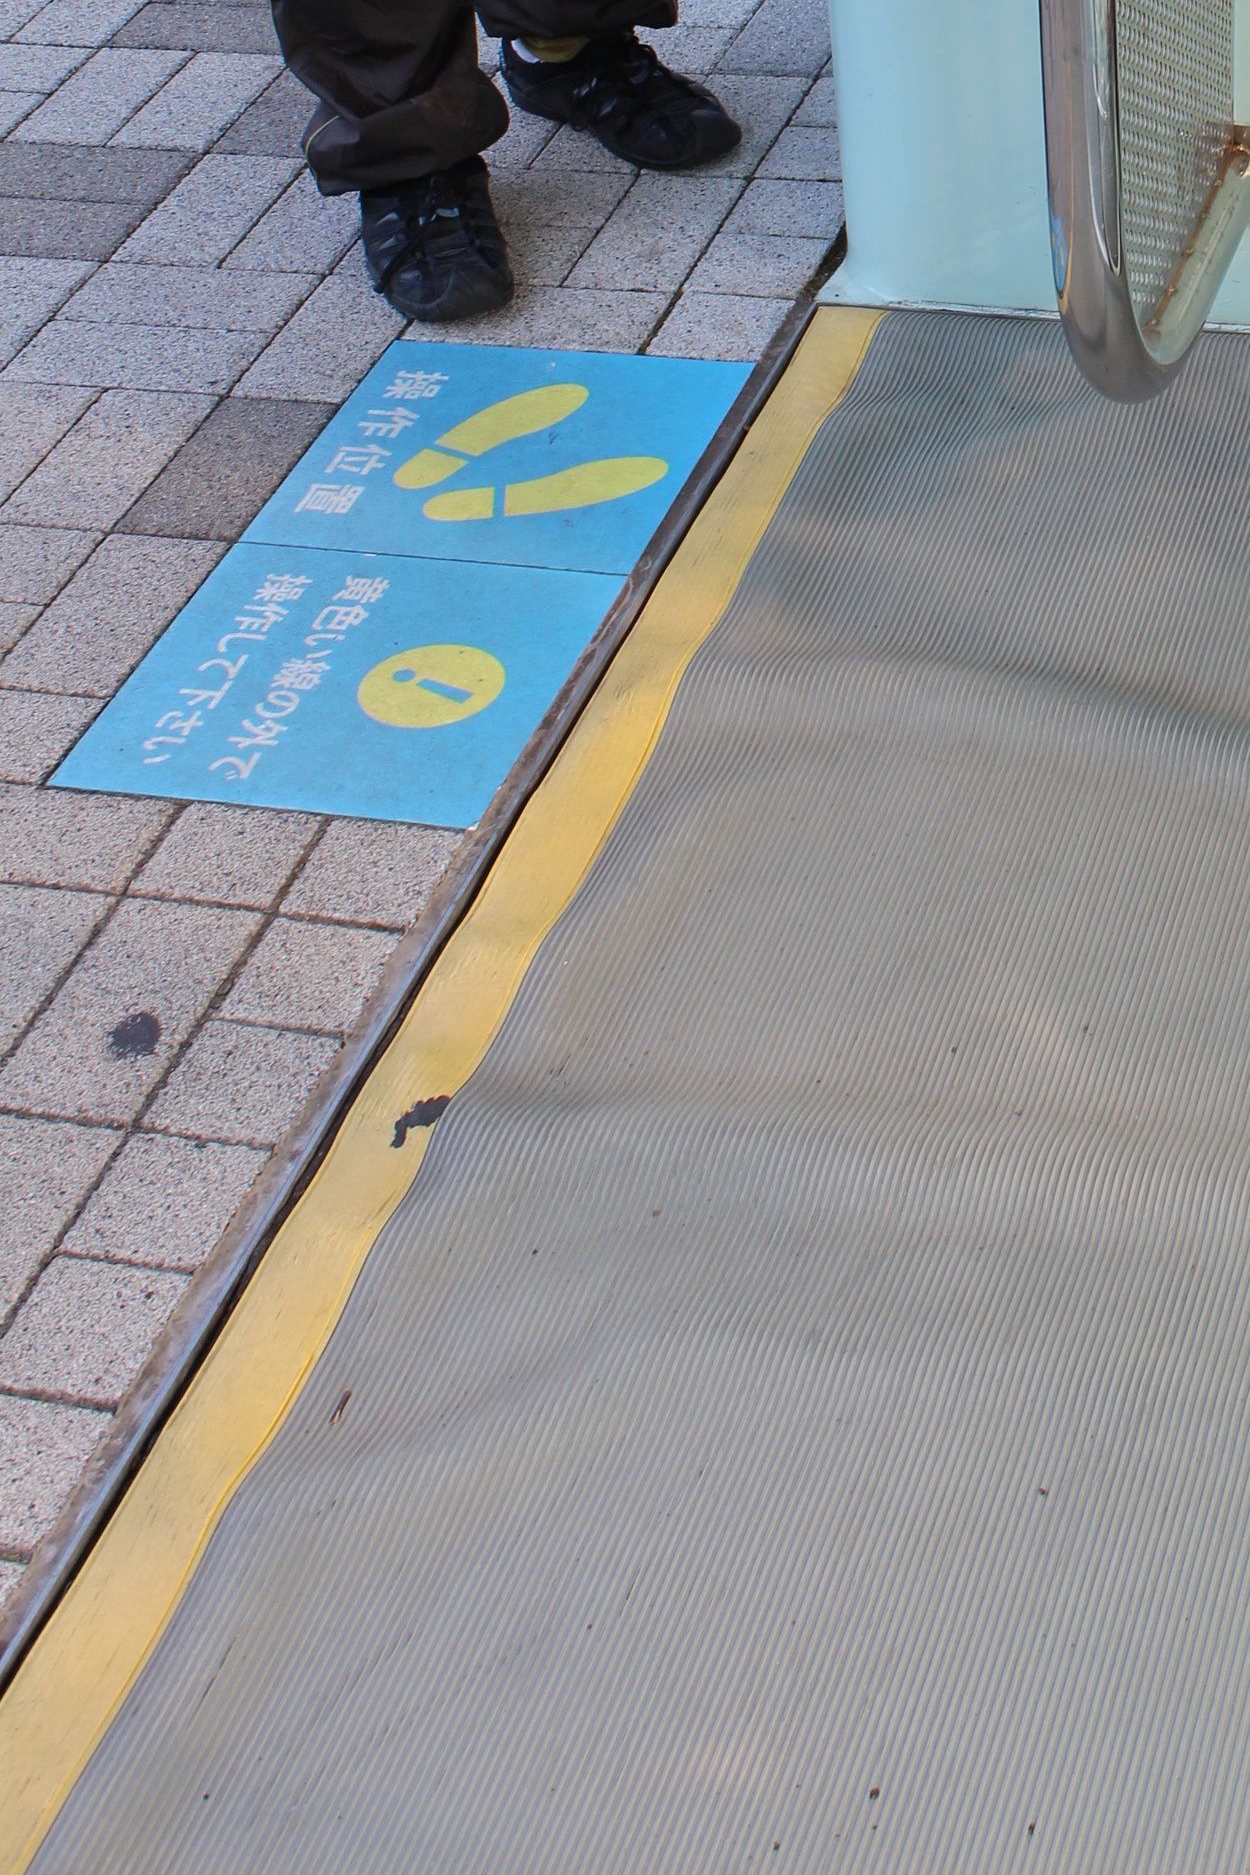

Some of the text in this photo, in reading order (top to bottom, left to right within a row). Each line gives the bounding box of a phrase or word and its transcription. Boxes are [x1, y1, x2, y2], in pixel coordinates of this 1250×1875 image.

[293, 369, 450, 518] 操作位置
[142, 573, 314, 765] 操作して下さい
[207, 574, 390, 781] 黄色い線の外で
